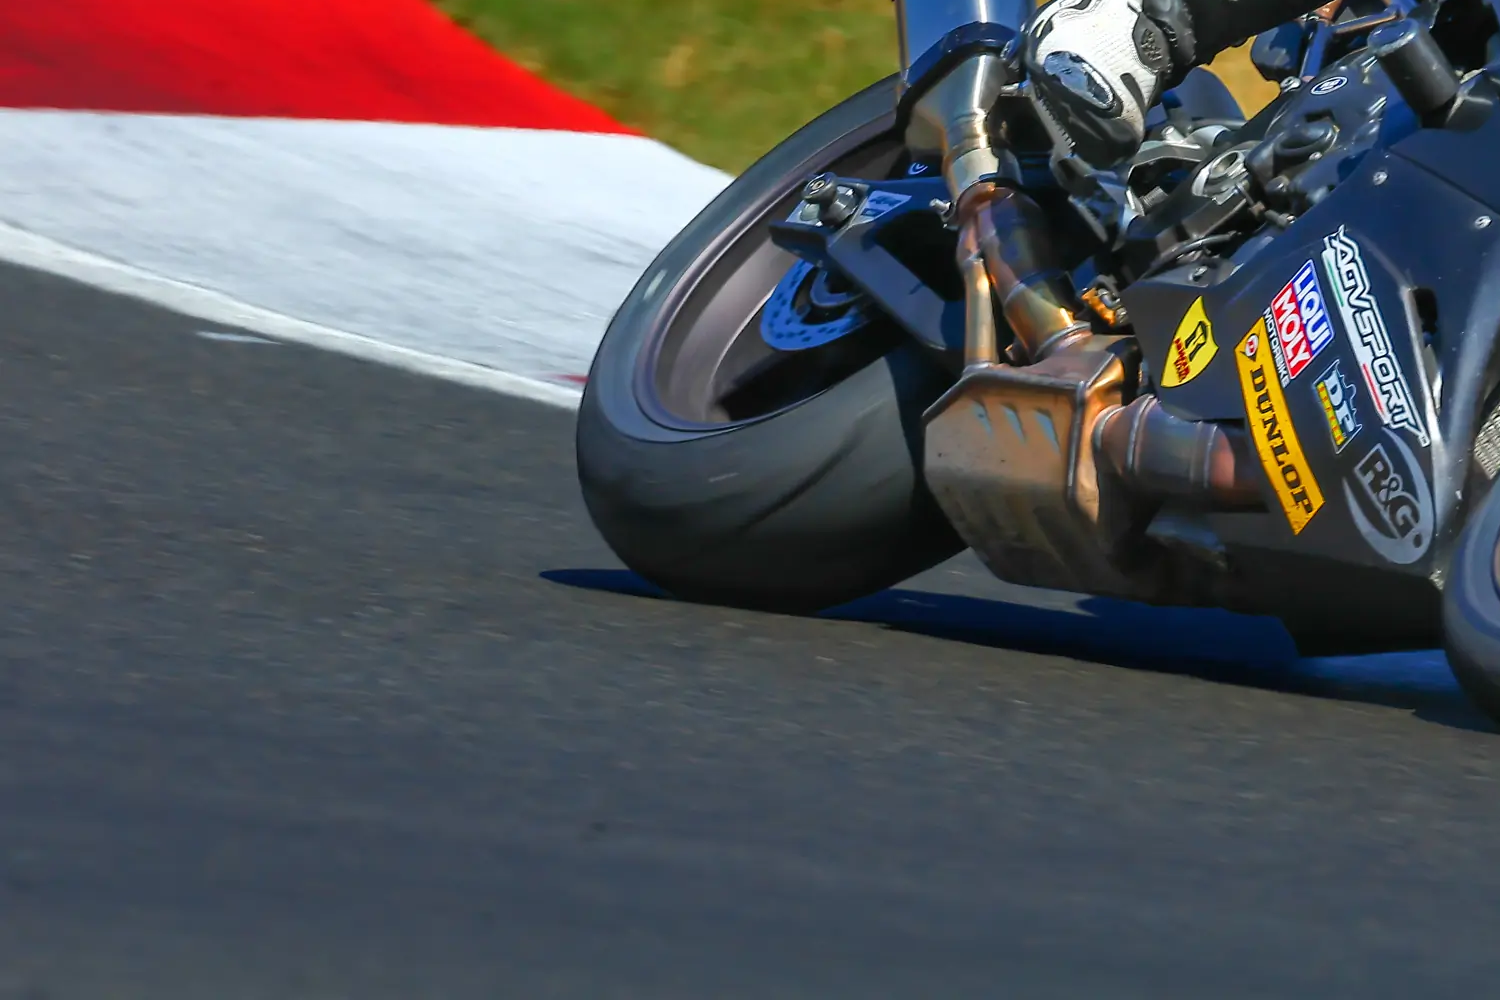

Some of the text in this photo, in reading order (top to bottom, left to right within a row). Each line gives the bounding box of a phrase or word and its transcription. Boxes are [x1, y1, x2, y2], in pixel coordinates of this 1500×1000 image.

[1263, 308, 1290, 387] MOTORBIKE
[1273, 290, 1312, 370] MOLY
[1293, 266, 1333, 348] LIQUI
[1330, 232, 1413, 430] AGVSPORT
[1249, 364, 1313, 515] DUNLOP
[1327, 373, 1355, 434] DP
[1362, 454, 1421, 540] R&G
